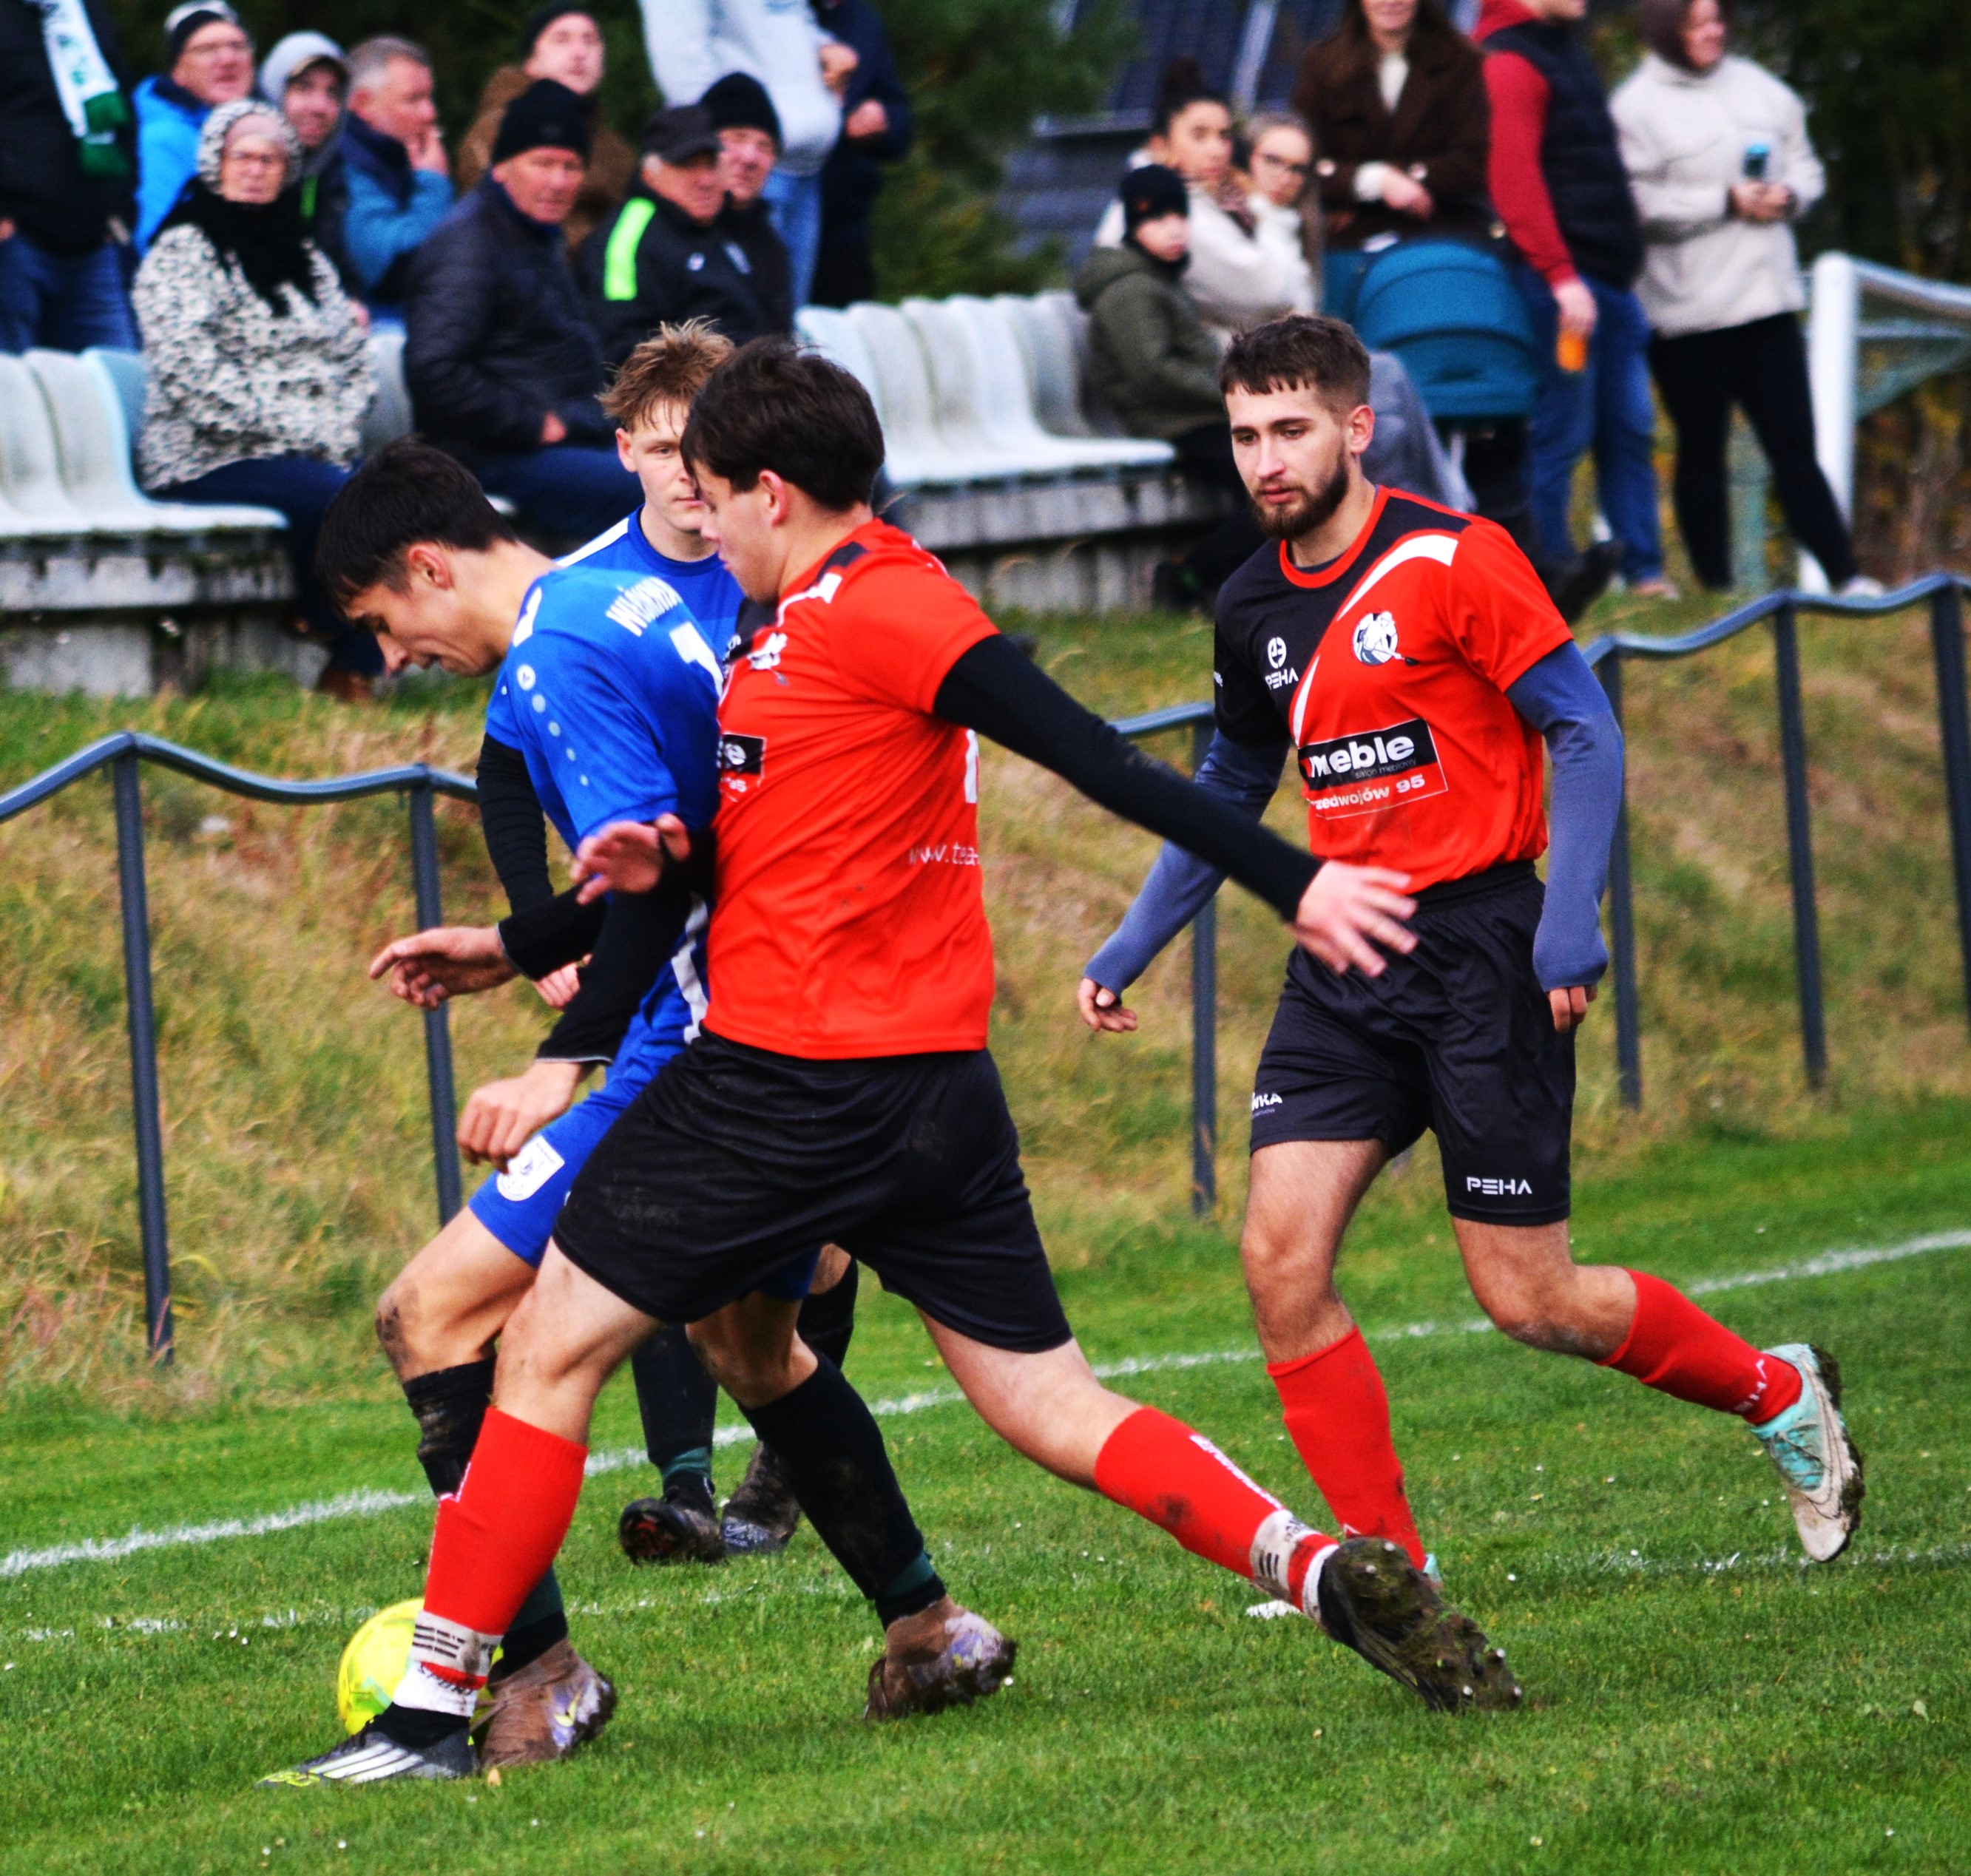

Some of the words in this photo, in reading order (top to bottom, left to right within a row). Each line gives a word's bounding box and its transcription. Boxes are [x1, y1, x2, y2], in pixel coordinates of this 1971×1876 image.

[1265, 667, 1299, 691] PEHA
[1307, 786, 1390, 810] zedwojów
[1396, 774, 1426, 793] 95
[1467, 1176, 1533, 1195] PEHA
